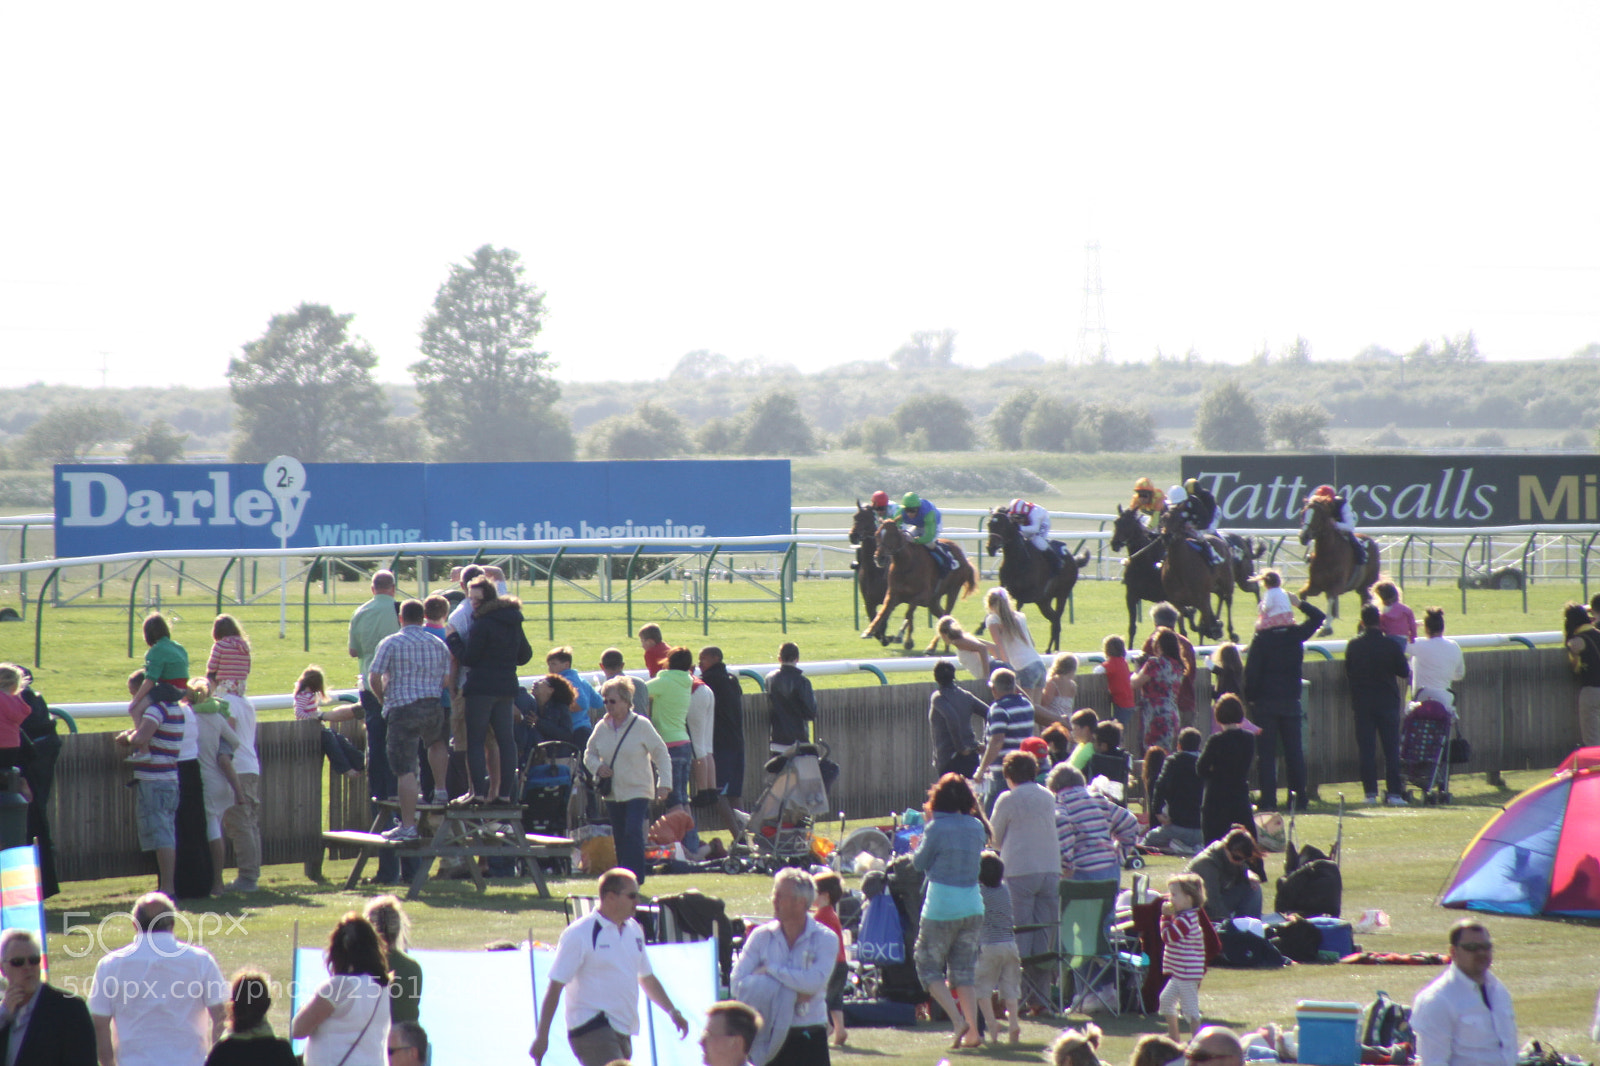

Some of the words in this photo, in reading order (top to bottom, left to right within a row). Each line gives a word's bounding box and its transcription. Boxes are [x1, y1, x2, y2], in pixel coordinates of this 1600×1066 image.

[276, 465, 295, 488] 2F
[61, 471, 311, 538] Darley
[1518, 474, 1598, 520] Mi
[451, 520, 474, 542] is
[478, 520, 527, 541] just
[533, 520, 575, 541] the
